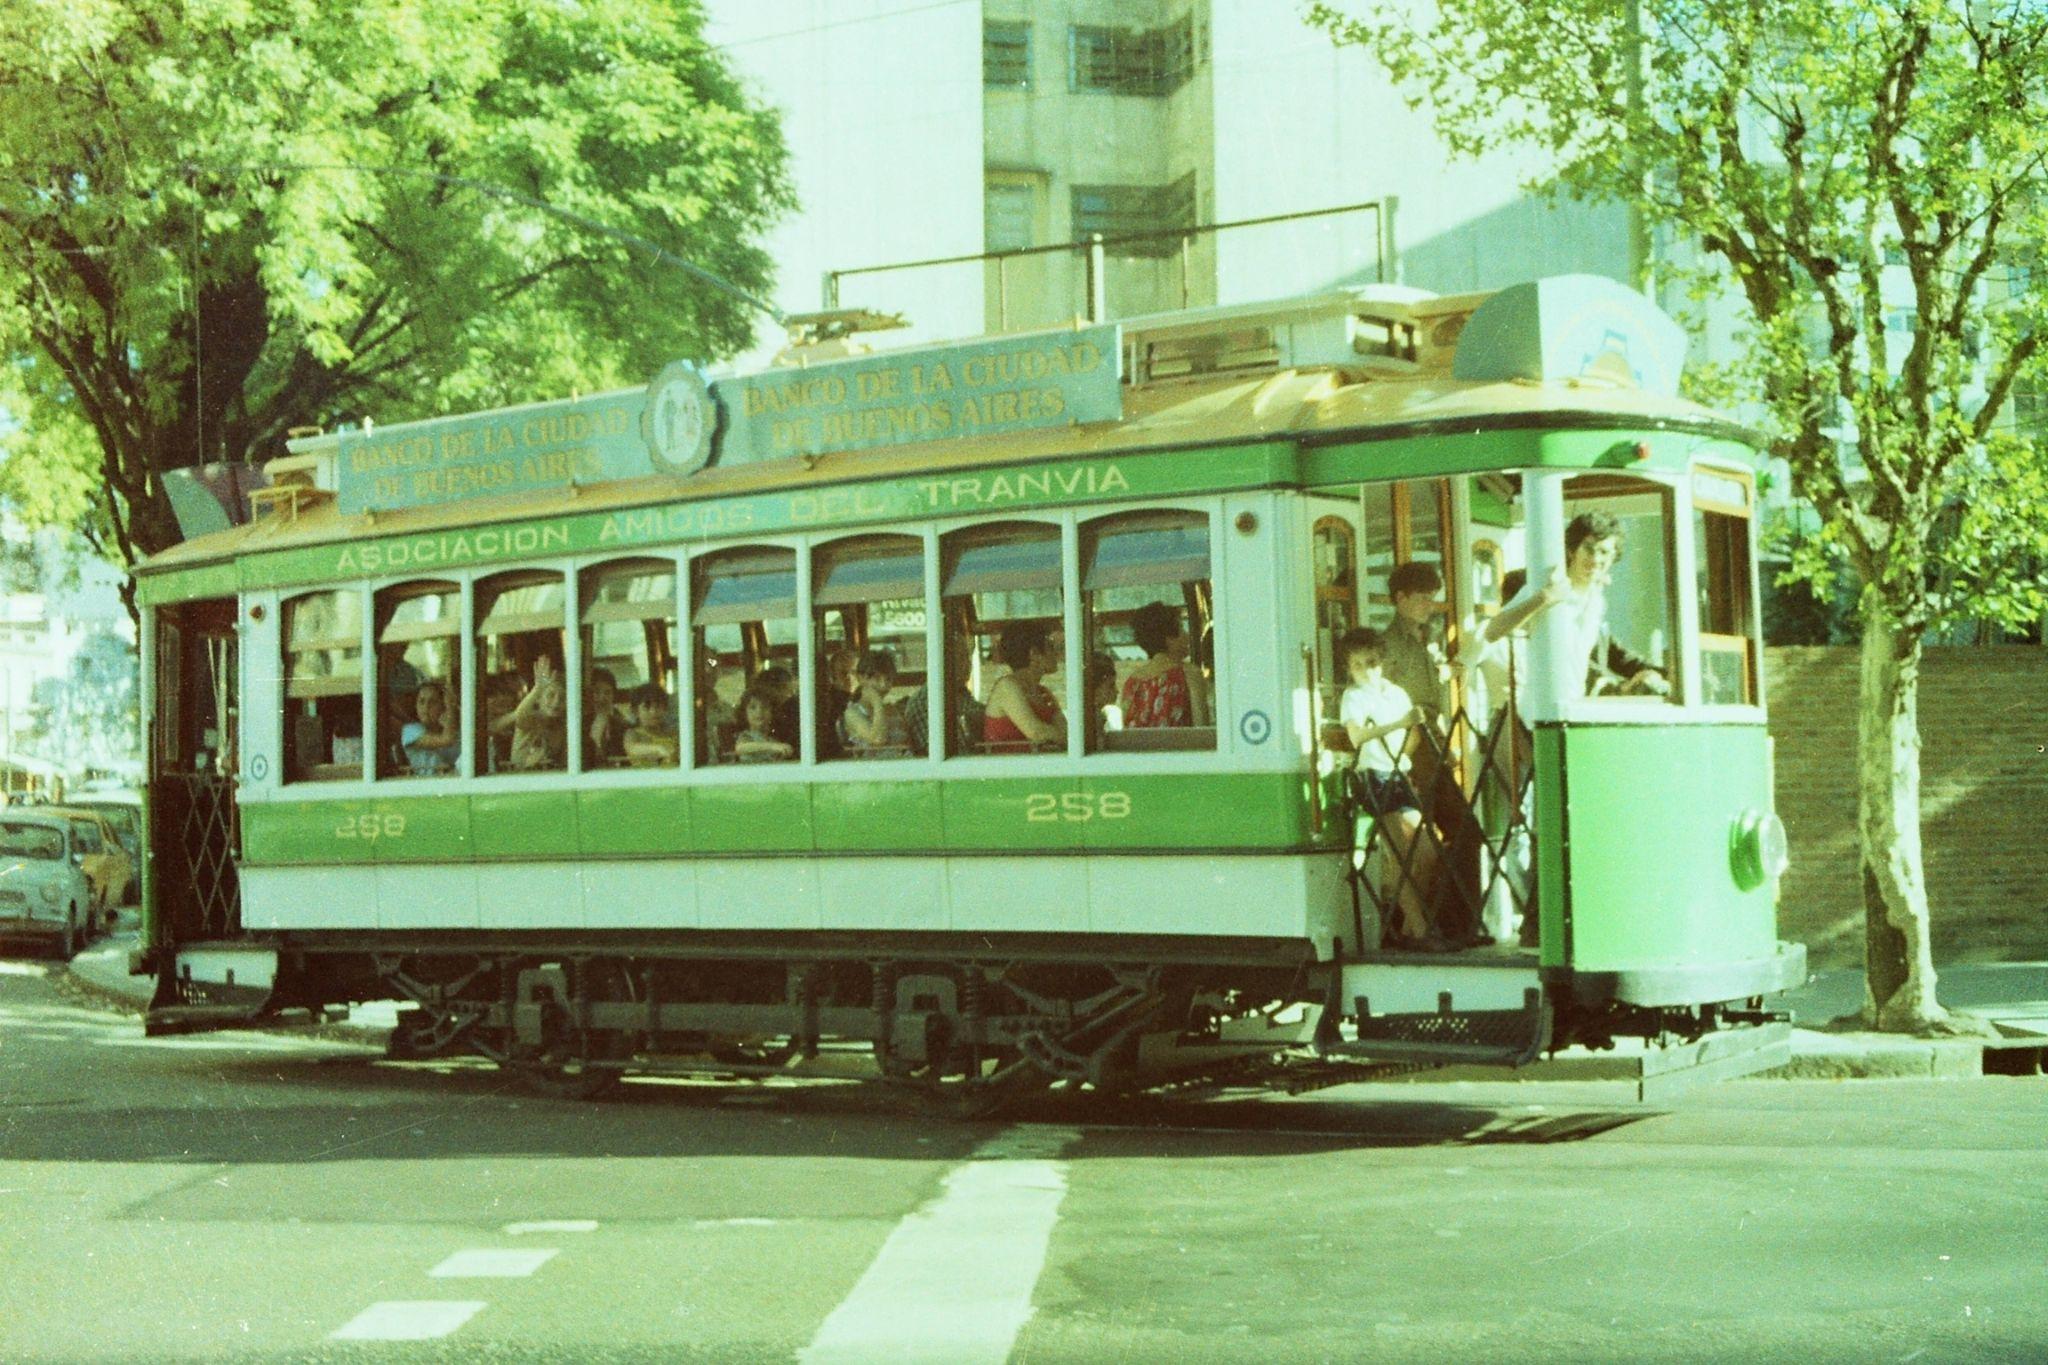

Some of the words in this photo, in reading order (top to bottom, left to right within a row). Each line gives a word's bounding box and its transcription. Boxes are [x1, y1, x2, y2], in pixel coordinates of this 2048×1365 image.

[743, 376, 846, 417] BANCO
[856, 368, 901, 400] DE
[912, 363, 952, 394] LA
[964, 341, 1100, 387] CIUDAD
[351, 436, 434, 473] BANCO
[440, 430, 477, 460] DE
[482, 425, 515, 453] LA
[523, 407, 630, 447] CIUDAD
[772, 418, 816, 449] DE
[823, 400, 952, 446] BUENOS
[959, 385, 1066, 428] AIRES
[336, 524, 569, 572] ASOCIACION
[790, 486, 886, 522] DEL
[916, 464, 1130, 506] TRANVIA
[335, 813, 406, 839] 258
[1025, 791, 1131, 822] 258
